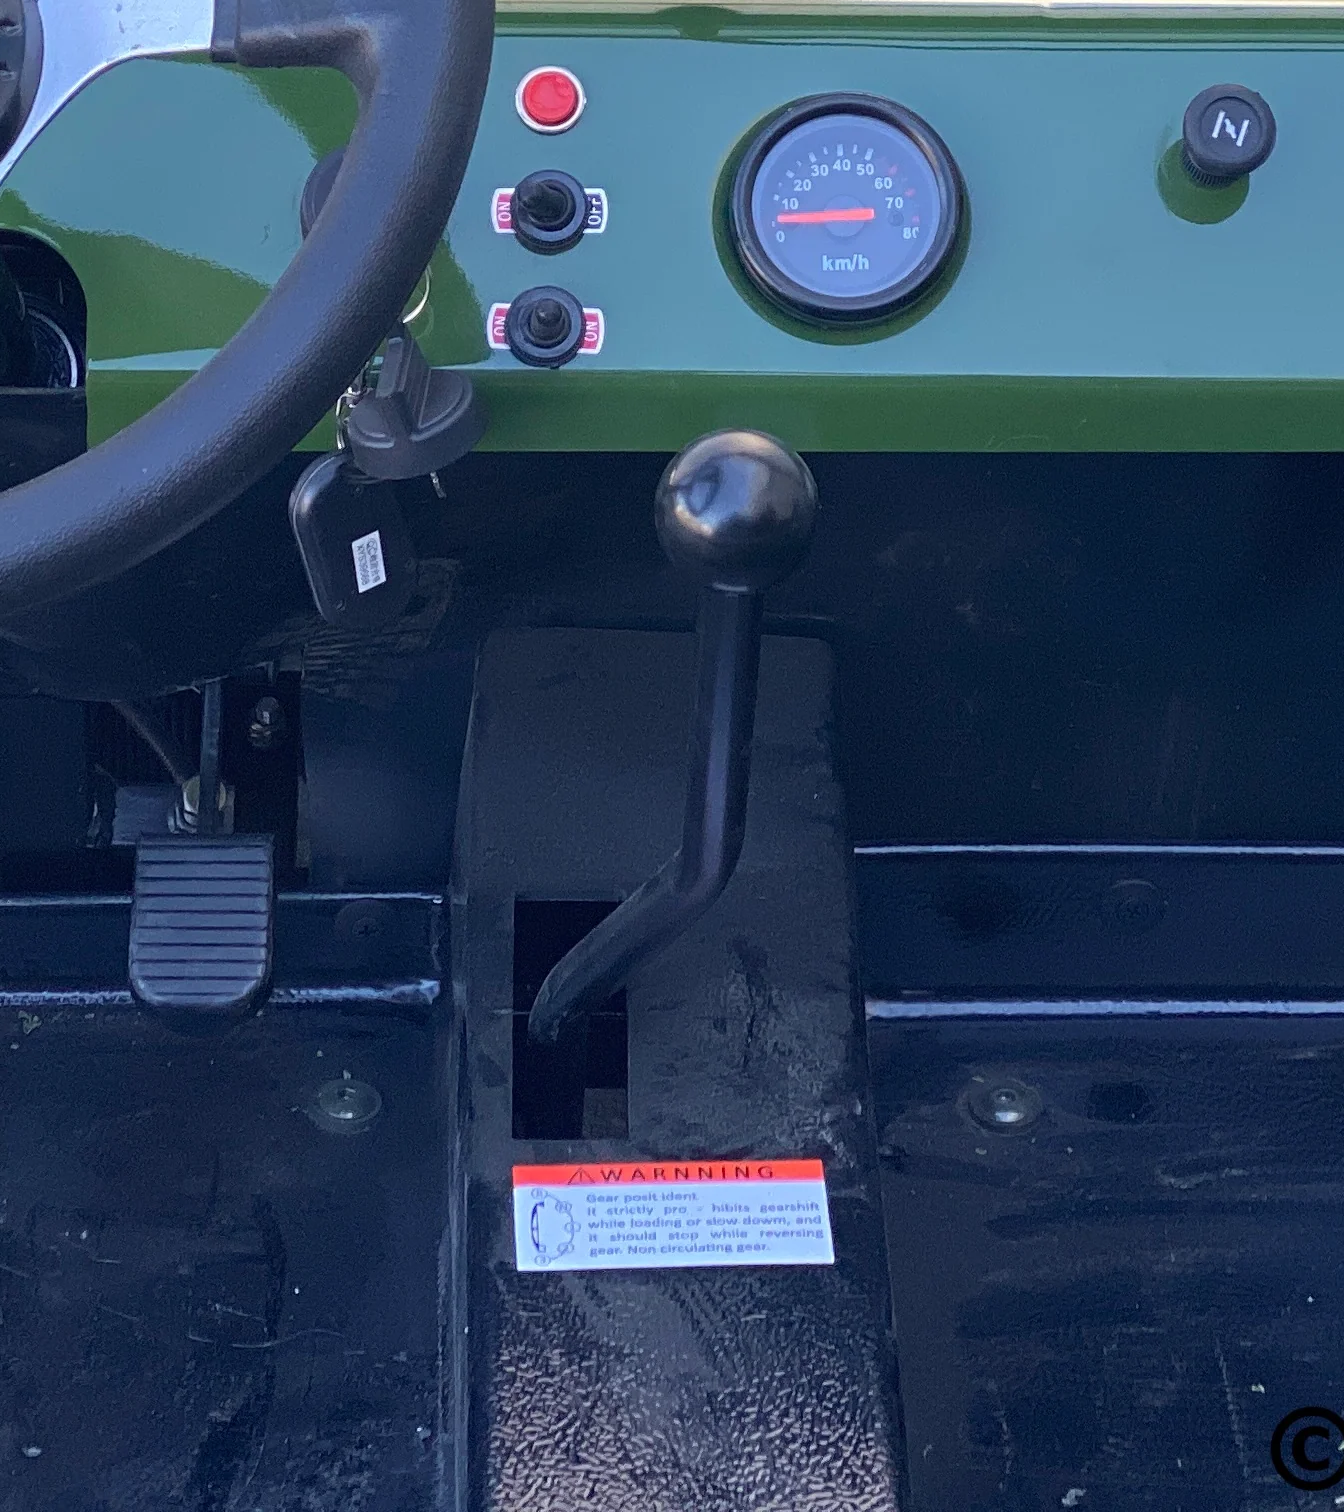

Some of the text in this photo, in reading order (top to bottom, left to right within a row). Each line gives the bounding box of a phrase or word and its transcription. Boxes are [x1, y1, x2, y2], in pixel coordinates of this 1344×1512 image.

[810, 164, 829, 177] 30
[833, 158, 852, 172] 40
[856, 163, 875, 176] 50
[793, 179, 812, 192] 20
[874, 177, 893, 190] 60
[781, 197, 799, 211] 10
[885, 196, 904, 210] 70
[497, 200, 512, 223] ON
[775, 230, 786, 243] 0
[822, 253, 870, 272] km/h
[584, 320, 598, 342] ON
[599, 1165, 774, 1183] WARNNING
[586, 1192, 619, 1204] Gear
[686, 1218, 702, 1228] or
[795, 1214, 822, 1226] and
